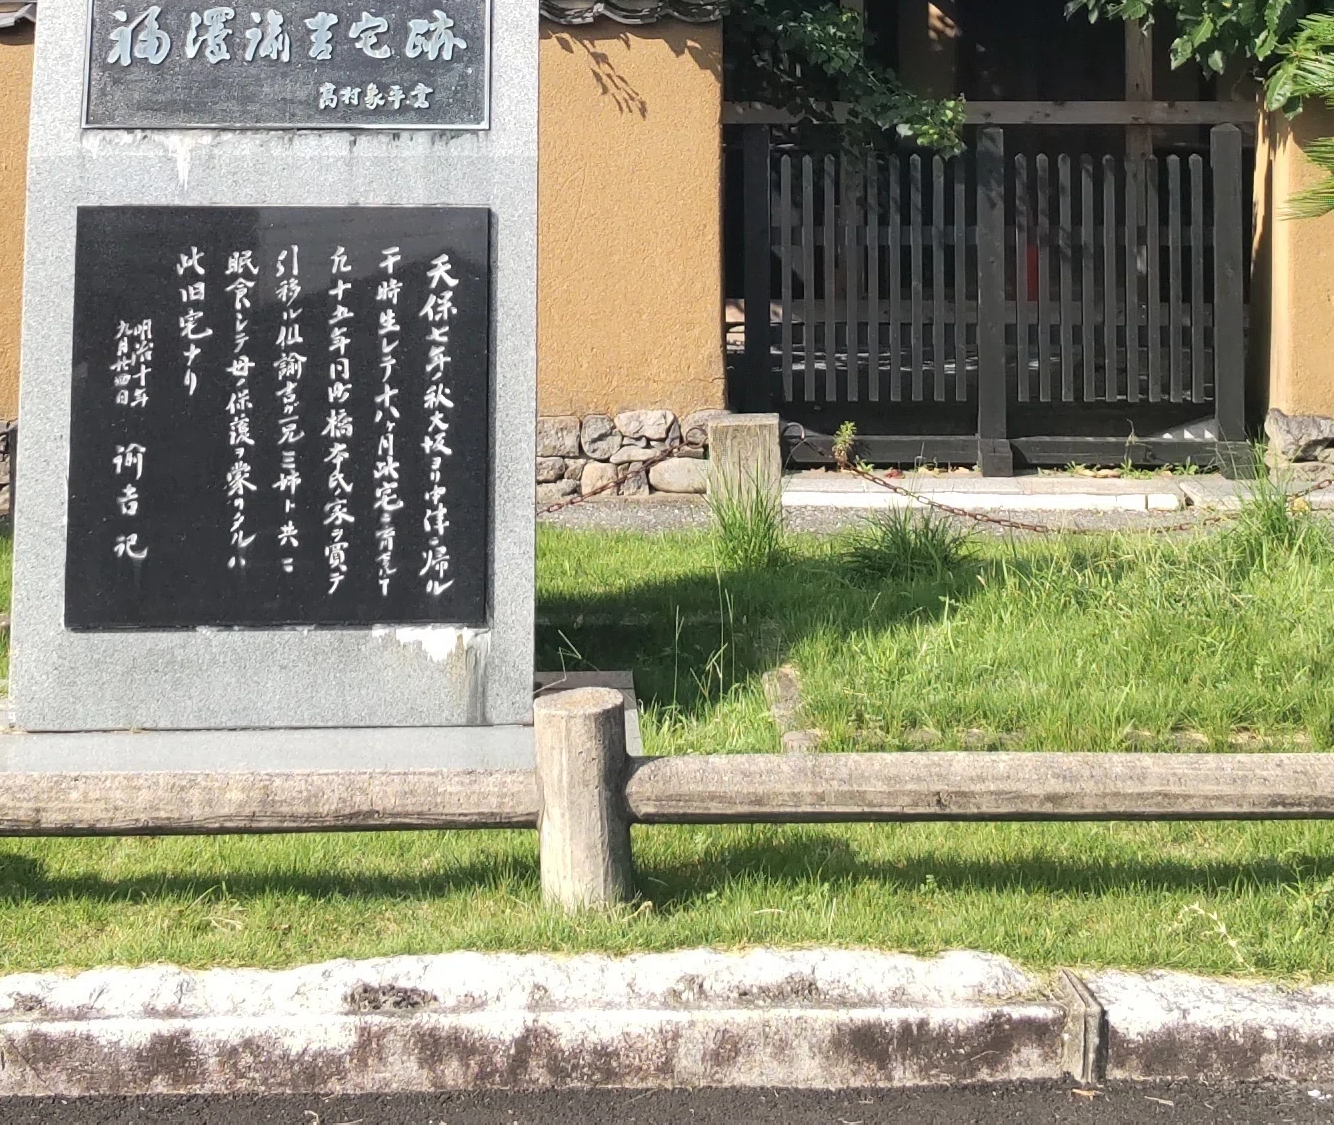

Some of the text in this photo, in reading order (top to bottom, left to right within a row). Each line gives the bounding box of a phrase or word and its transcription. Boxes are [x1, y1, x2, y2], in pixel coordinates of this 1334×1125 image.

[175, 246, 214, 397] 此旧宅ナリ
